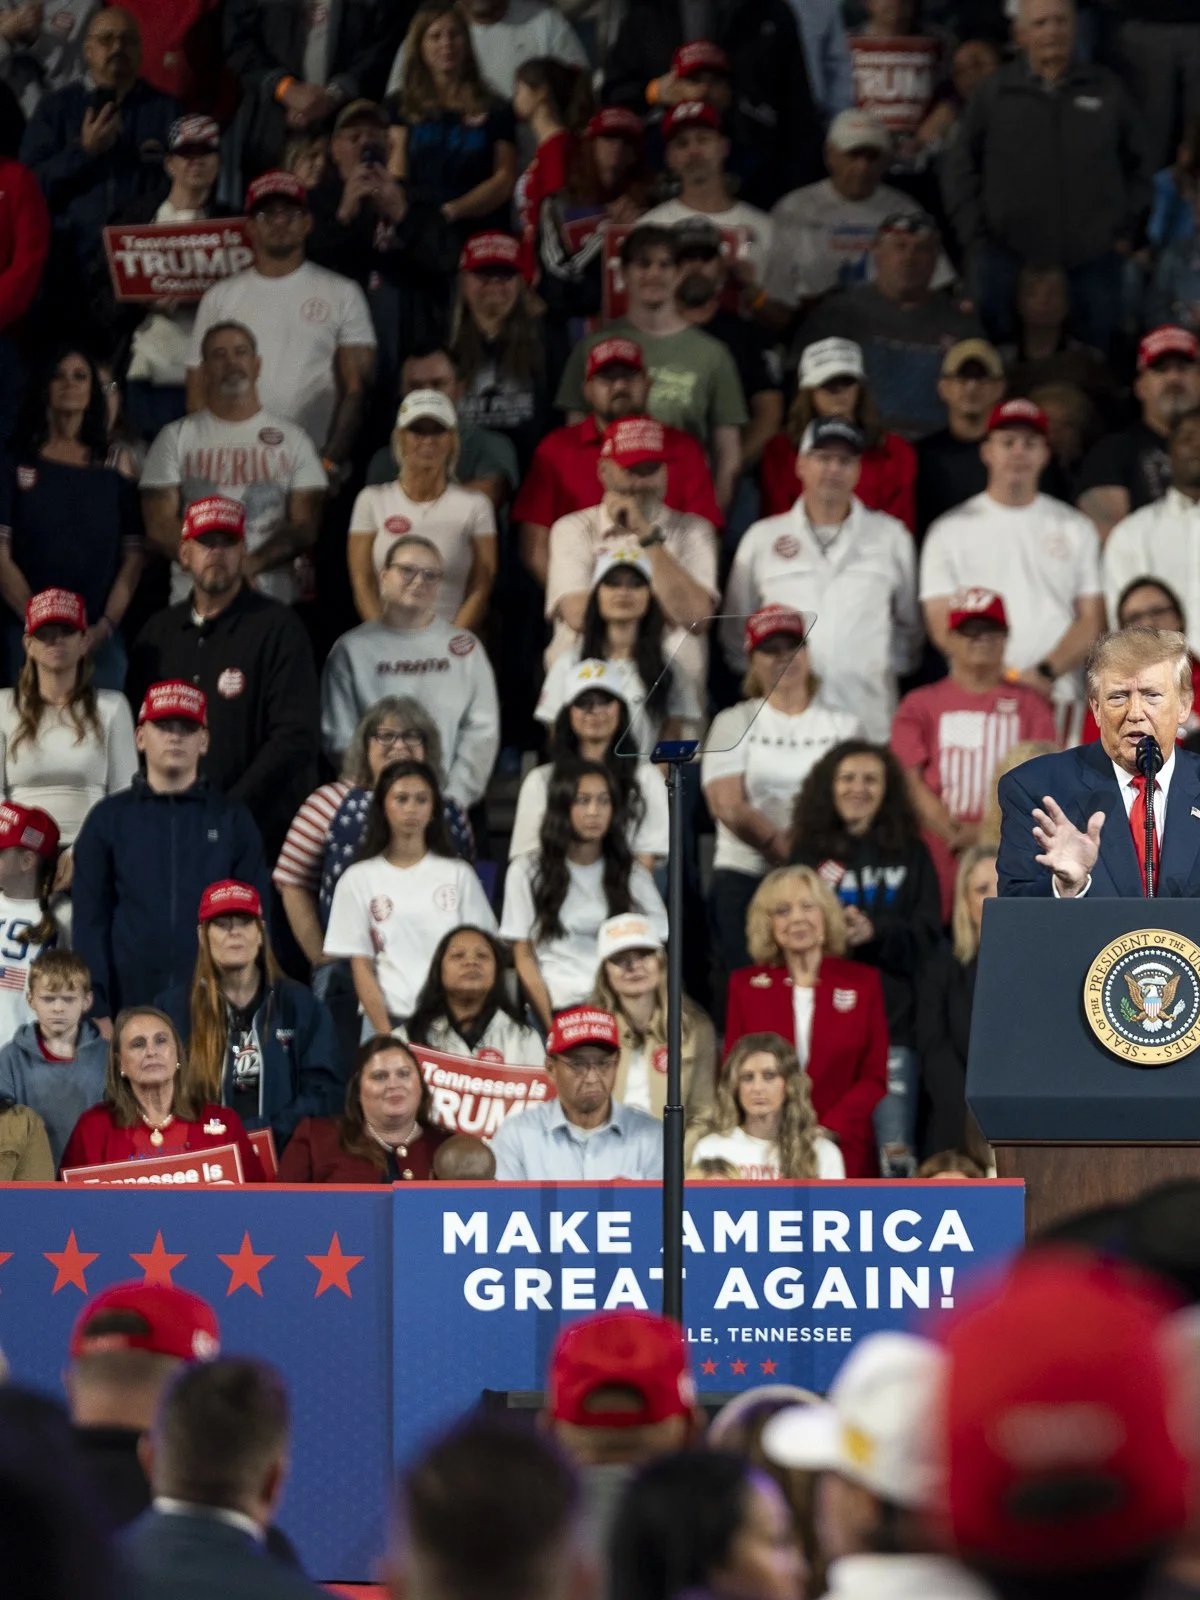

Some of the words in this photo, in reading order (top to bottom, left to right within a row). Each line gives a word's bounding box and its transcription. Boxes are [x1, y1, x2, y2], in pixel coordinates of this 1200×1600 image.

[115, 246, 253, 278] TRUMP
[1153, 935, 1167, 944] OF
[1169, 938, 1186, 952] THE
[1089, 933, 1150, 993] PRESIDENT
[1090, 997, 1101, 1017] THE
[558, 1012, 581, 1029] MAKE
[582, 1010, 615, 1027] AMERICA
[563, 1023, 589, 1040] GREAT
[1096, 1018, 1106, 1031] OF
[1105, 1029, 1141, 1058] SEAL
[421, 1061, 527, 1099] Tennessee
[428, 1084, 545, 1138] RUM
[443, 1211, 632, 1254] MAKE
[714, 1266, 955, 1310] AGAIN!
[728, 1327, 852, 1343] TENNESSEE
